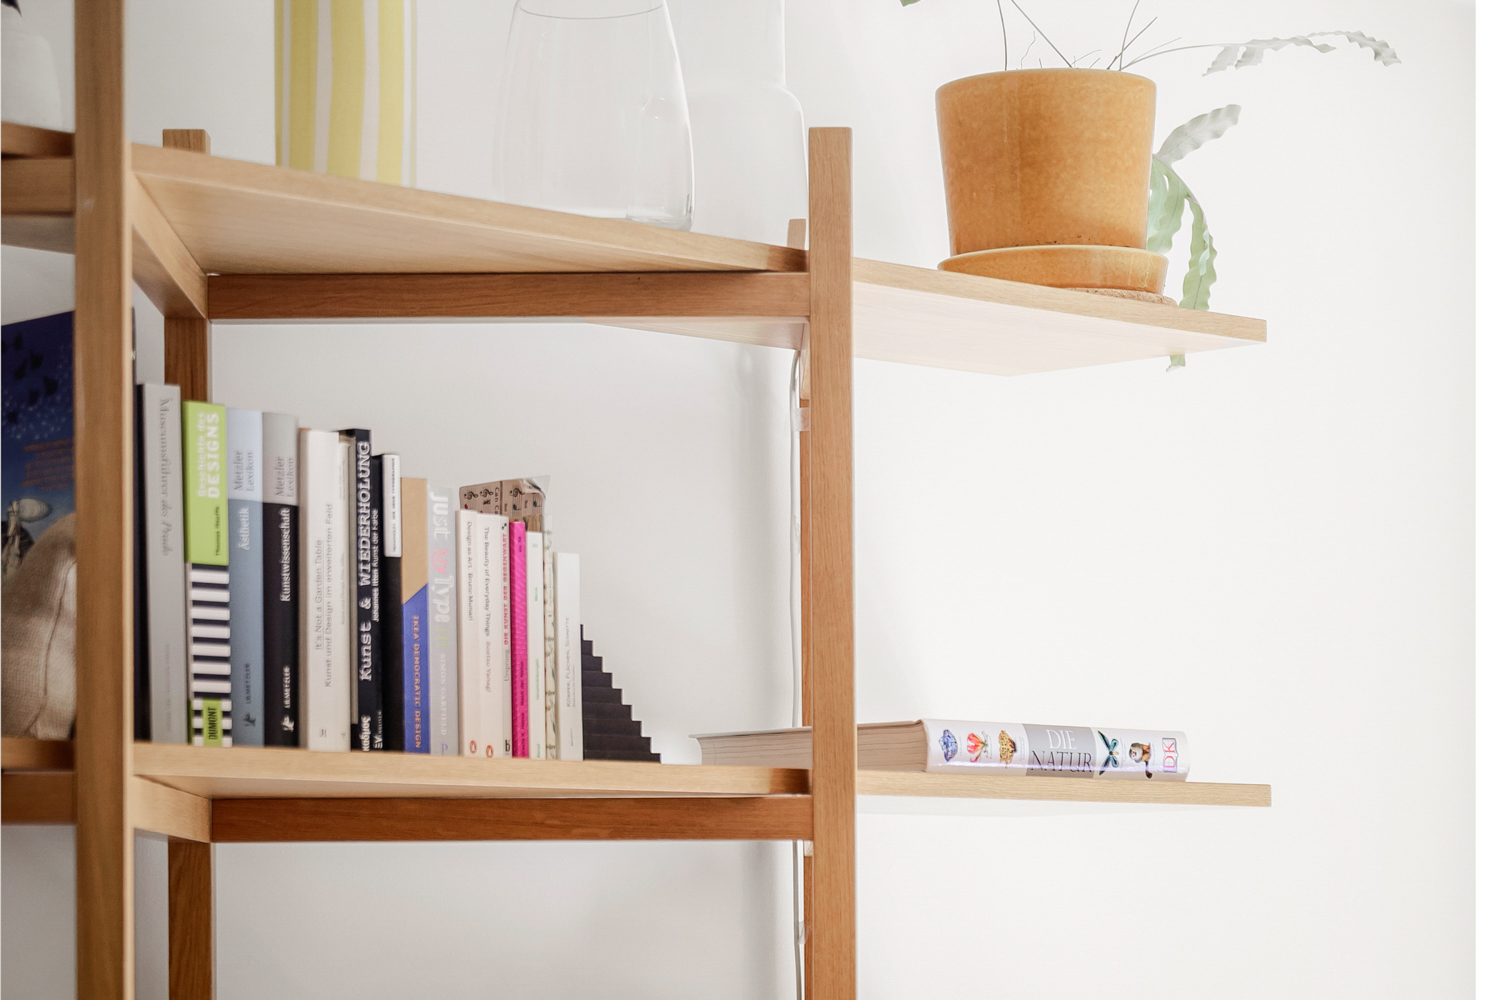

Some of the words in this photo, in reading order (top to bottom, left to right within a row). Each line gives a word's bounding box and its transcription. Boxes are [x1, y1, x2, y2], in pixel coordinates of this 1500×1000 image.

[196, 410, 206, 431] des
[160, 397, 173, 498] Museumsführer
[206, 411, 221, 499] DESIGNS
[196, 432, 207, 498] Geschichte
[234, 450, 245, 491] Metzler
[245, 452, 255, 492] Lexikon
[275, 456, 286, 497] Metzler
[286, 457, 295, 498] Lexikon
[237, 506, 251, 551] Ästhetik
[324, 503, 333, 524] Feld
[357, 441, 372, 587] WIEDERHOLUNG
[371, 509, 379, 530] Farbe
[313, 539, 323, 565] Table
[371, 532, 379, 545] der
[483, 541, 491, 567] Beauty
[279, 508, 292, 602] Kunstwissenschaft
[325, 527, 333, 583] erweiterten
[371, 546, 379, 568] Kunst
[314, 566, 323, 604] Garden
[372, 569, 380, 587] Itten
[484, 568, 491, 576] of
[325, 586, 333, 599] im
[359, 597, 372, 610] &
[372, 587, 380, 623] Johannes
[431, 575, 455, 623] Type
[483, 577, 491, 612] Everyday
[314, 614, 323, 633] Not
[325, 600, 335, 635] Design
[412, 615, 420, 640] IKEA
[484, 613, 492, 637] Things
[314, 635, 323, 651] It's
[325, 637, 333, 657] und
[359, 620, 372, 681] Kunst
[325, 658, 333, 688] Kunst
[413, 643, 421, 708] DEMOCRATIC
[439, 653, 447, 684] SIMON
[484, 668, 492, 693] Yanagi
[207, 706, 218, 740] DUMONT
[439, 687, 448, 736] GARFIELD
[414, 710, 422, 749] DESIGN
[1046, 729, 1076, 751] DIE
[1031, 750, 1093, 774] NATUR
[1163, 740, 1176, 770] DK
